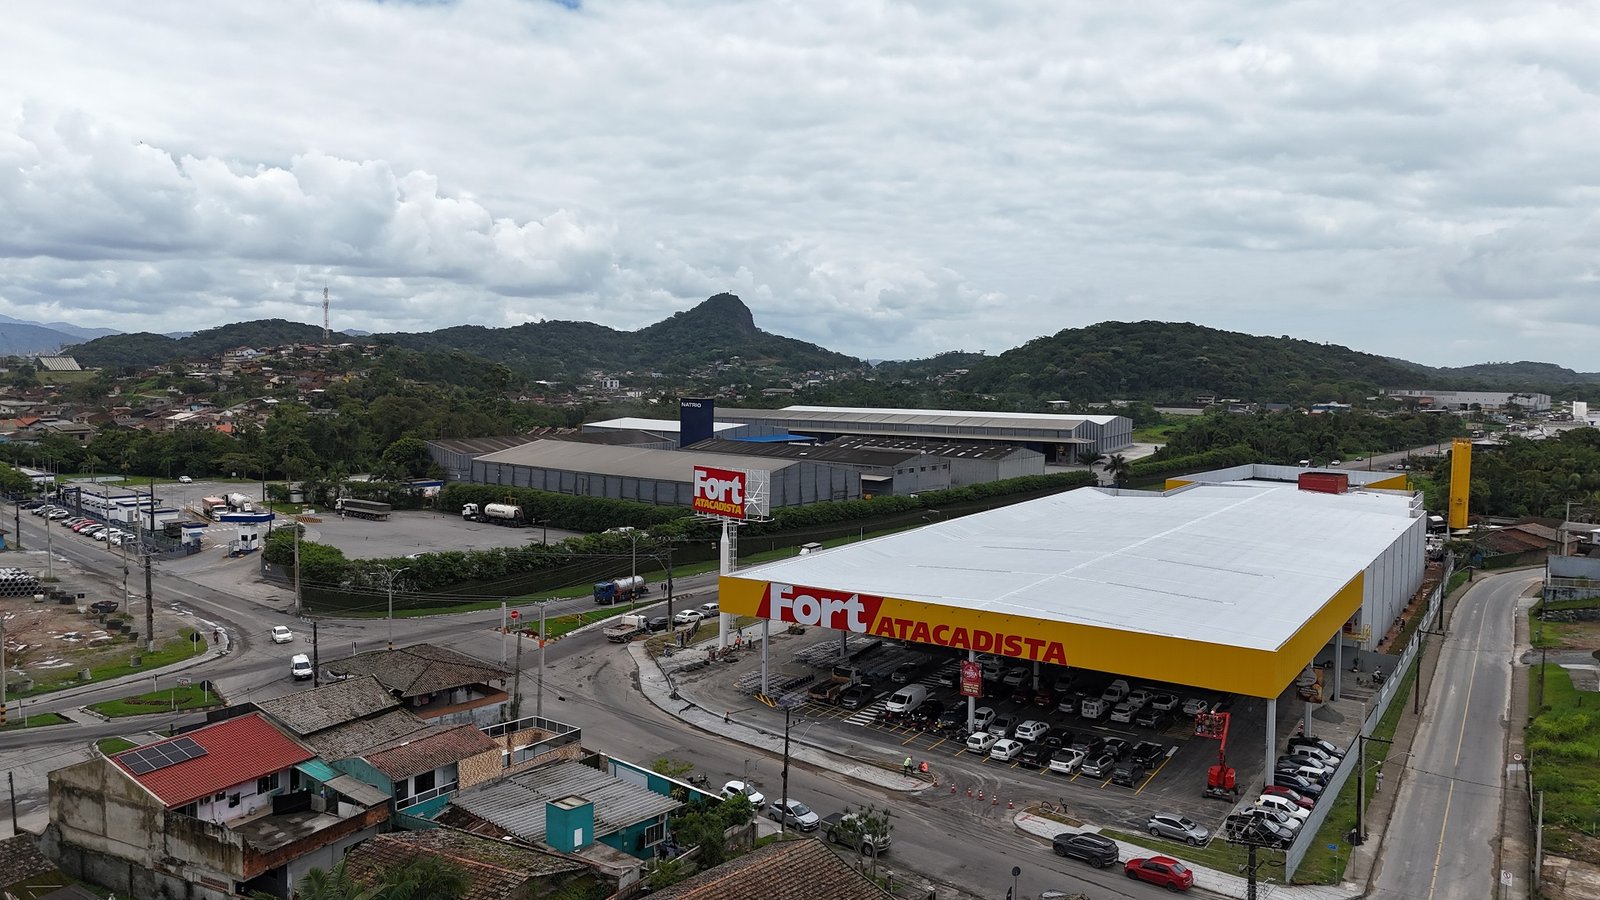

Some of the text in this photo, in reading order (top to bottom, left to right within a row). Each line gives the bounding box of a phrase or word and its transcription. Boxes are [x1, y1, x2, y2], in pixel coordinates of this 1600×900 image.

[694, 470, 742, 504] Fort
[695, 498, 741, 514] ATACADISTA
[770, 582, 1067, 665] Fort ATACADISTA
